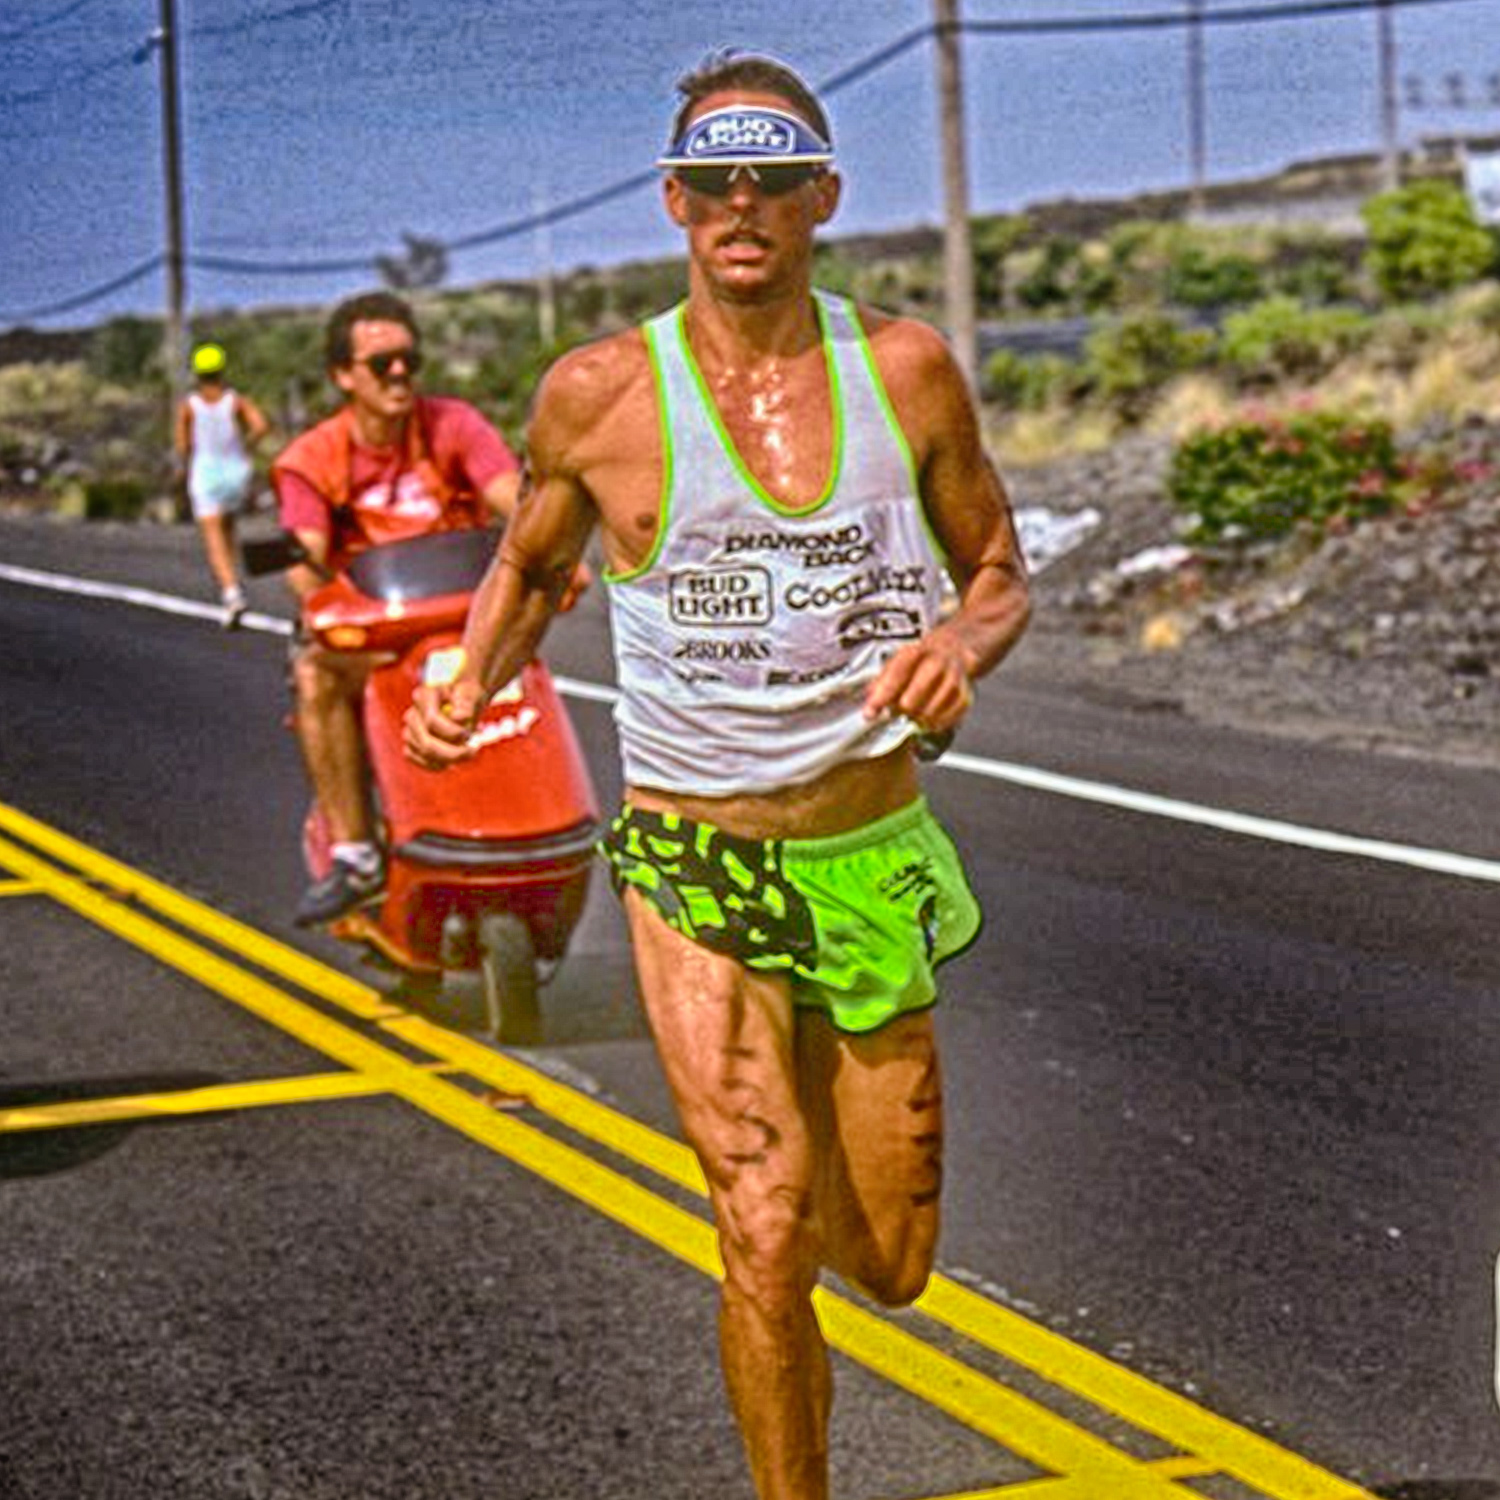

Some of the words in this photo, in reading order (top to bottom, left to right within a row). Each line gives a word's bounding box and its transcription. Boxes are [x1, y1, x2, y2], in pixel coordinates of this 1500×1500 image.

[725, 524, 861, 552] DIAMOND
[804, 541, 874, 568] BACK
[689, 574, 749, 594] BUD
[678, 595, 763, 617] LIGHT
[687, 639, 770, 660] BROOKS
